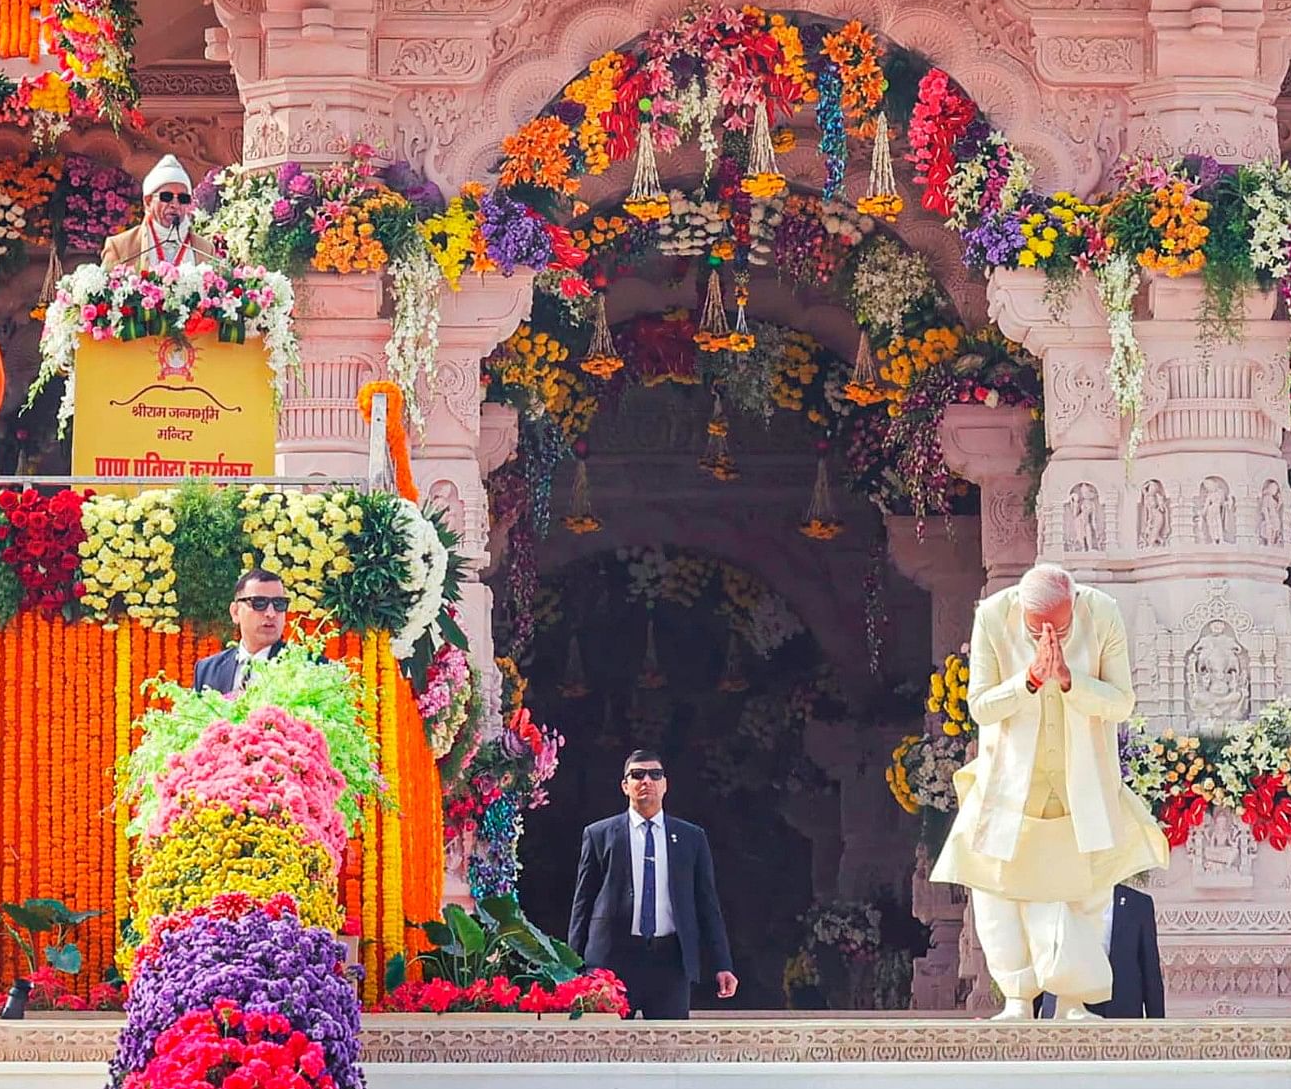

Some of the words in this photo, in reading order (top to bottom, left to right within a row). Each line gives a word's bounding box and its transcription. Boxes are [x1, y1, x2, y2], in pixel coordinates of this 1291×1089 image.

[132, 402, 166, 418] श्रीराम
[168, 405, 220, 424] जन्मभूमि
[157, 426, 194, 442] मन्दिर
